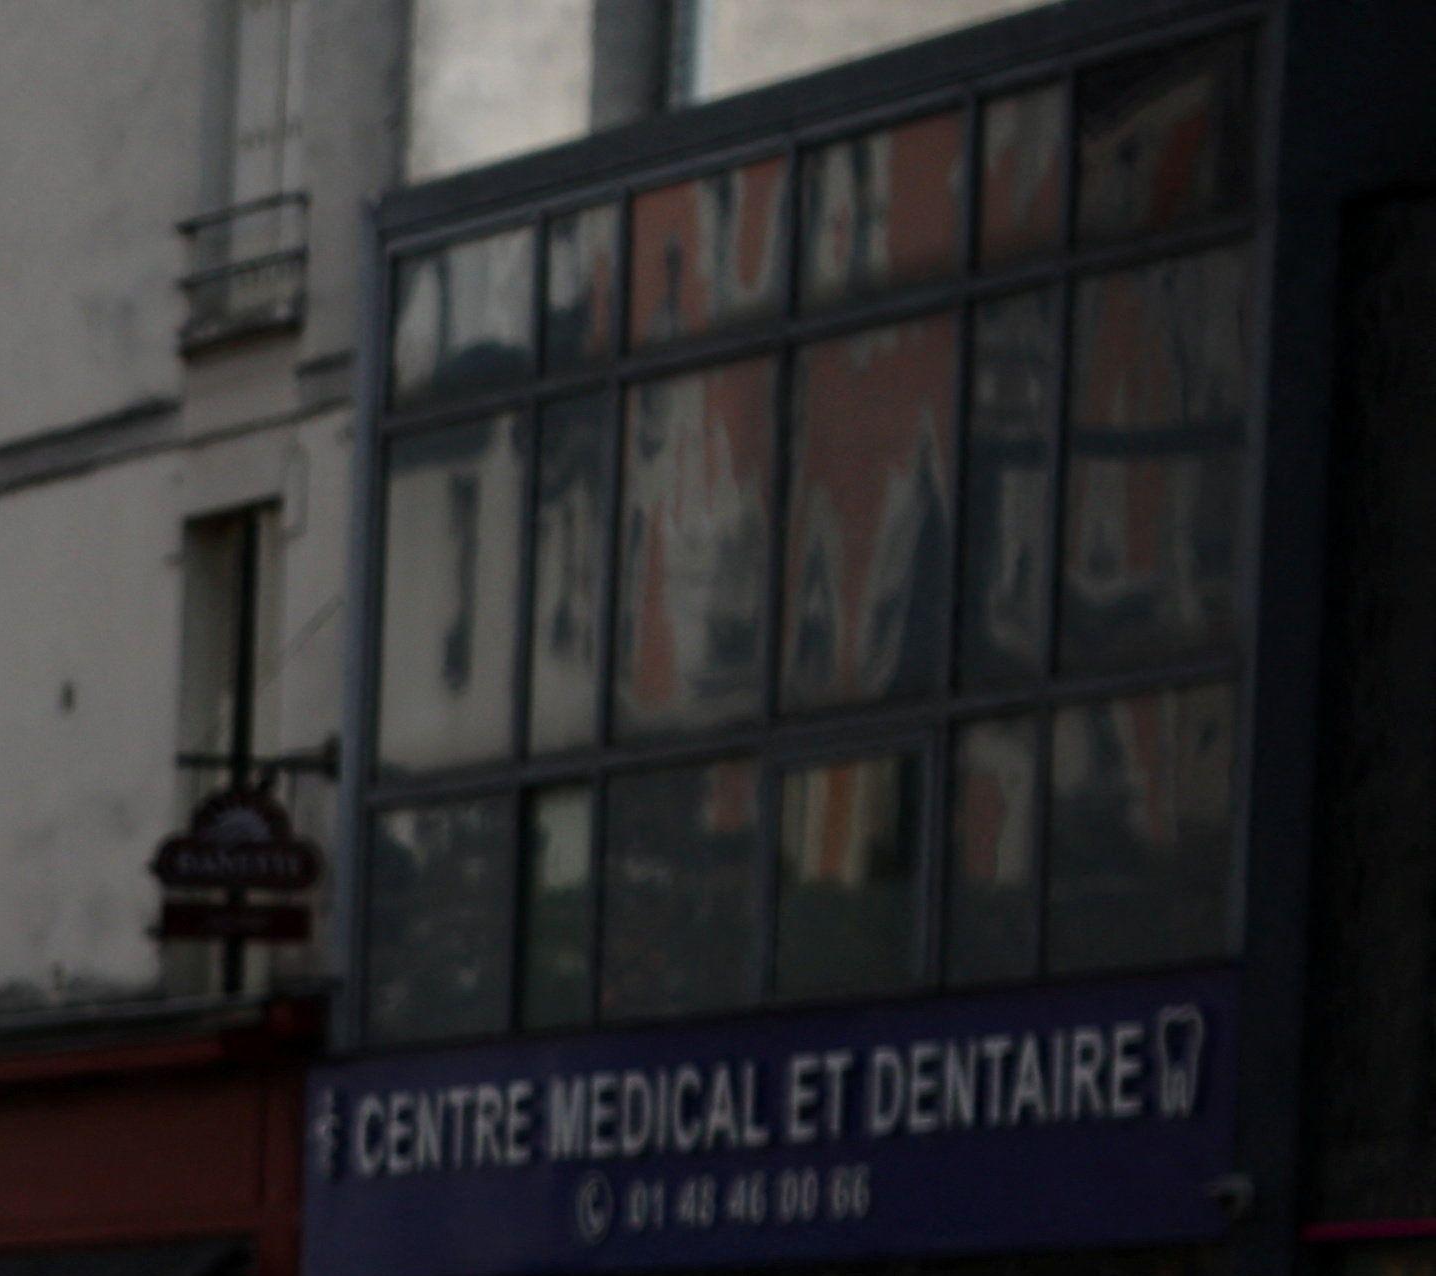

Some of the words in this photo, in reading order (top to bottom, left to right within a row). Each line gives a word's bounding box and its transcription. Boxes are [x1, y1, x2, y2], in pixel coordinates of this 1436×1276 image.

[354, 1080, 533, 1177] CENTRE
[548, 1062, 769, 1162] MEDICAL
[786, 1048, 855, 1144] ET
[865, 1021, 1145, 1138] DENTAIRE
[626, 1178, 665, 1230] 01
[728, 1169, 768, 1225] 46
[779, 1166, 819, 1222] 00
[829, 1162, 871, 1221] 66
